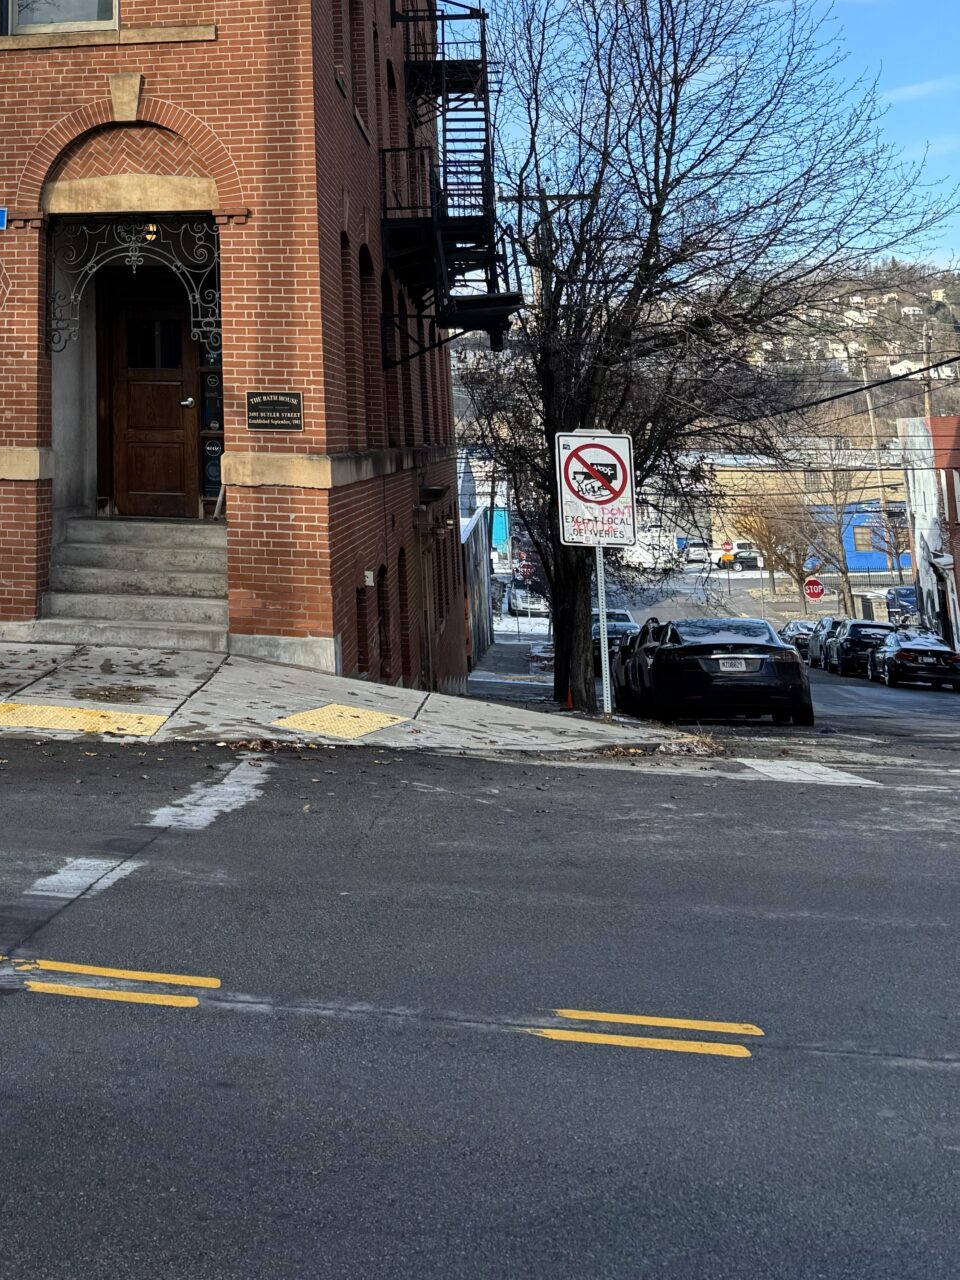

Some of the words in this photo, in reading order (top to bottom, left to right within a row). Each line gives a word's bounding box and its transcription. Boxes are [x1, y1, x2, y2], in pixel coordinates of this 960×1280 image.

[250, 396, 262, 404] THE
[278, 395, 299, 405] HOUSE
[601, 516, 632, 526] LOCAL
[805, 585, 823, 594] STOP
